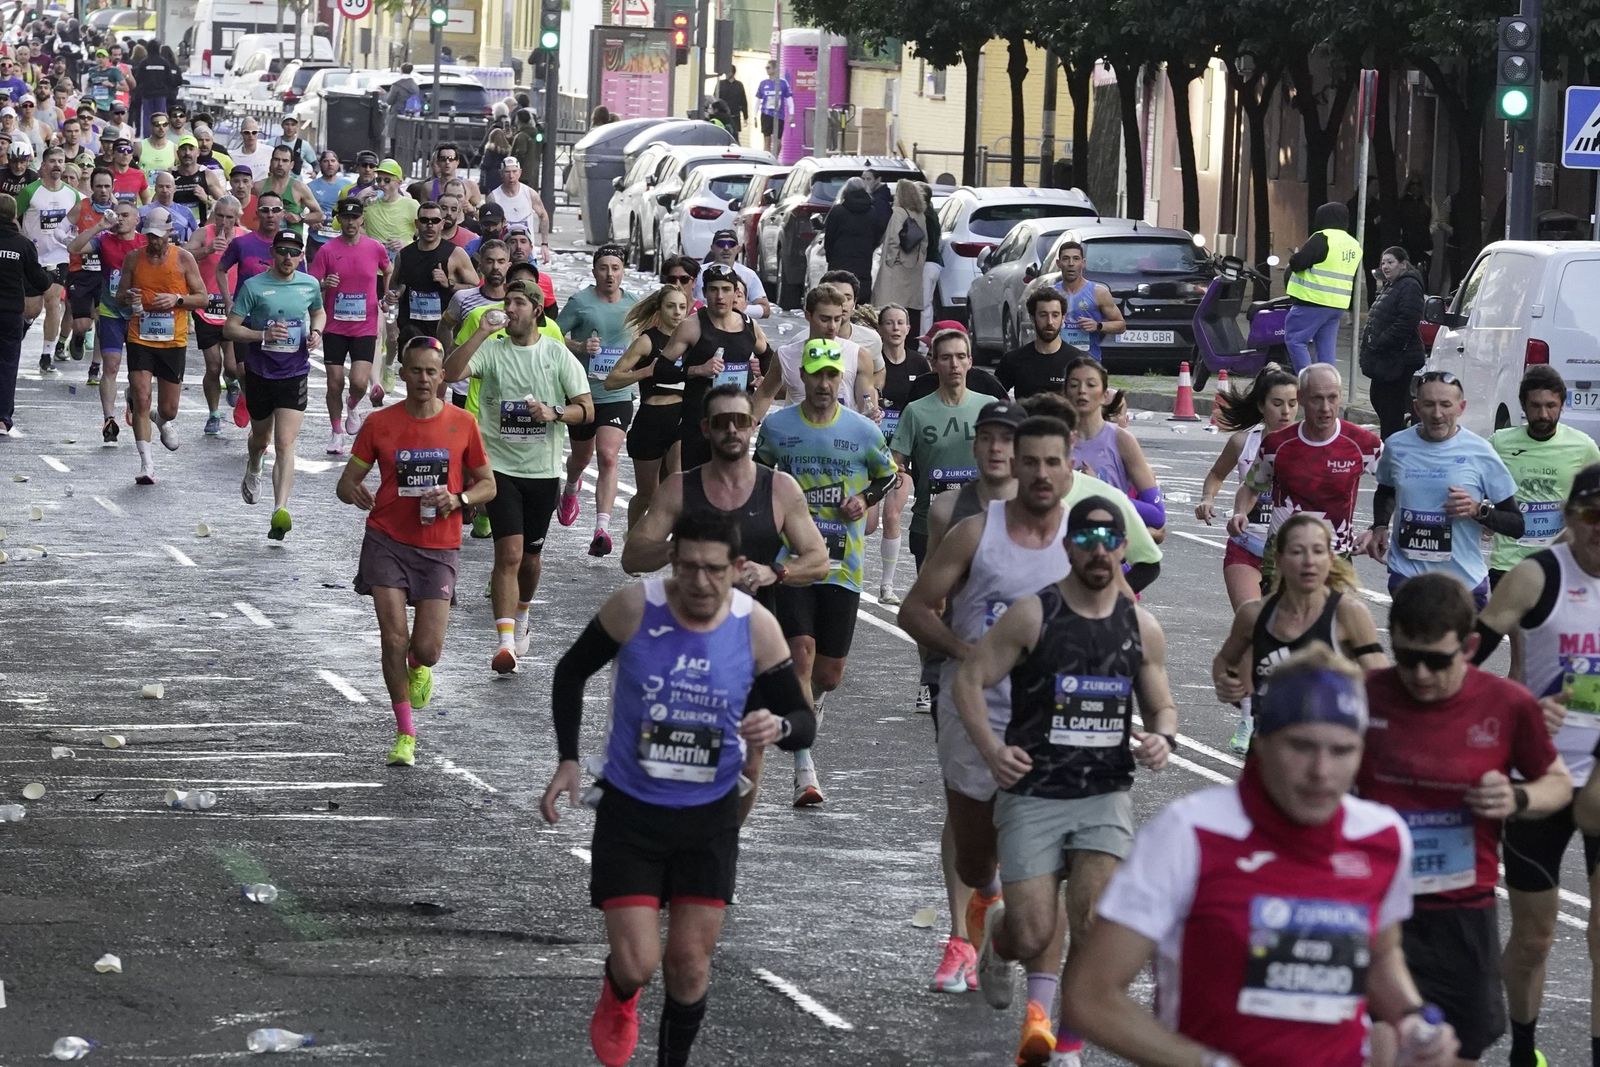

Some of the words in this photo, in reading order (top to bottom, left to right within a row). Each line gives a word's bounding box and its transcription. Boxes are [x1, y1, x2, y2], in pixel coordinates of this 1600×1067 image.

[1518, 145, 1525, 153] 2
[1342, 249, 1356, 263] Life
[1123, 332, 1149, 342] 4249
[1152, 333, 1172, 342] GBR
[1574, 393, 1599, 405] 917
[834, 439, 850, 449] OTSO
[414, 451, 443, 459] ZURICH
[795, 455, 851, 466] FISIOTERAPIA
[1327, 460, 1356, 468] HUN
[1415, 515, 1446, 523] ZURICH
[1408, 538, 1439, 550] ALAIN
[1082, 681, 1123, 692] ZURICH
[671, 709, 718, 723] ZURICH
[1052, 715, 1068, 728] EL
[1069, 717, 1124, 730] CAPILLITA
[669, 731, 696, 743] 4772
[649, 744, 711, 764] MARTÍN
[1265, 961, 1353, 994] SERGIO
